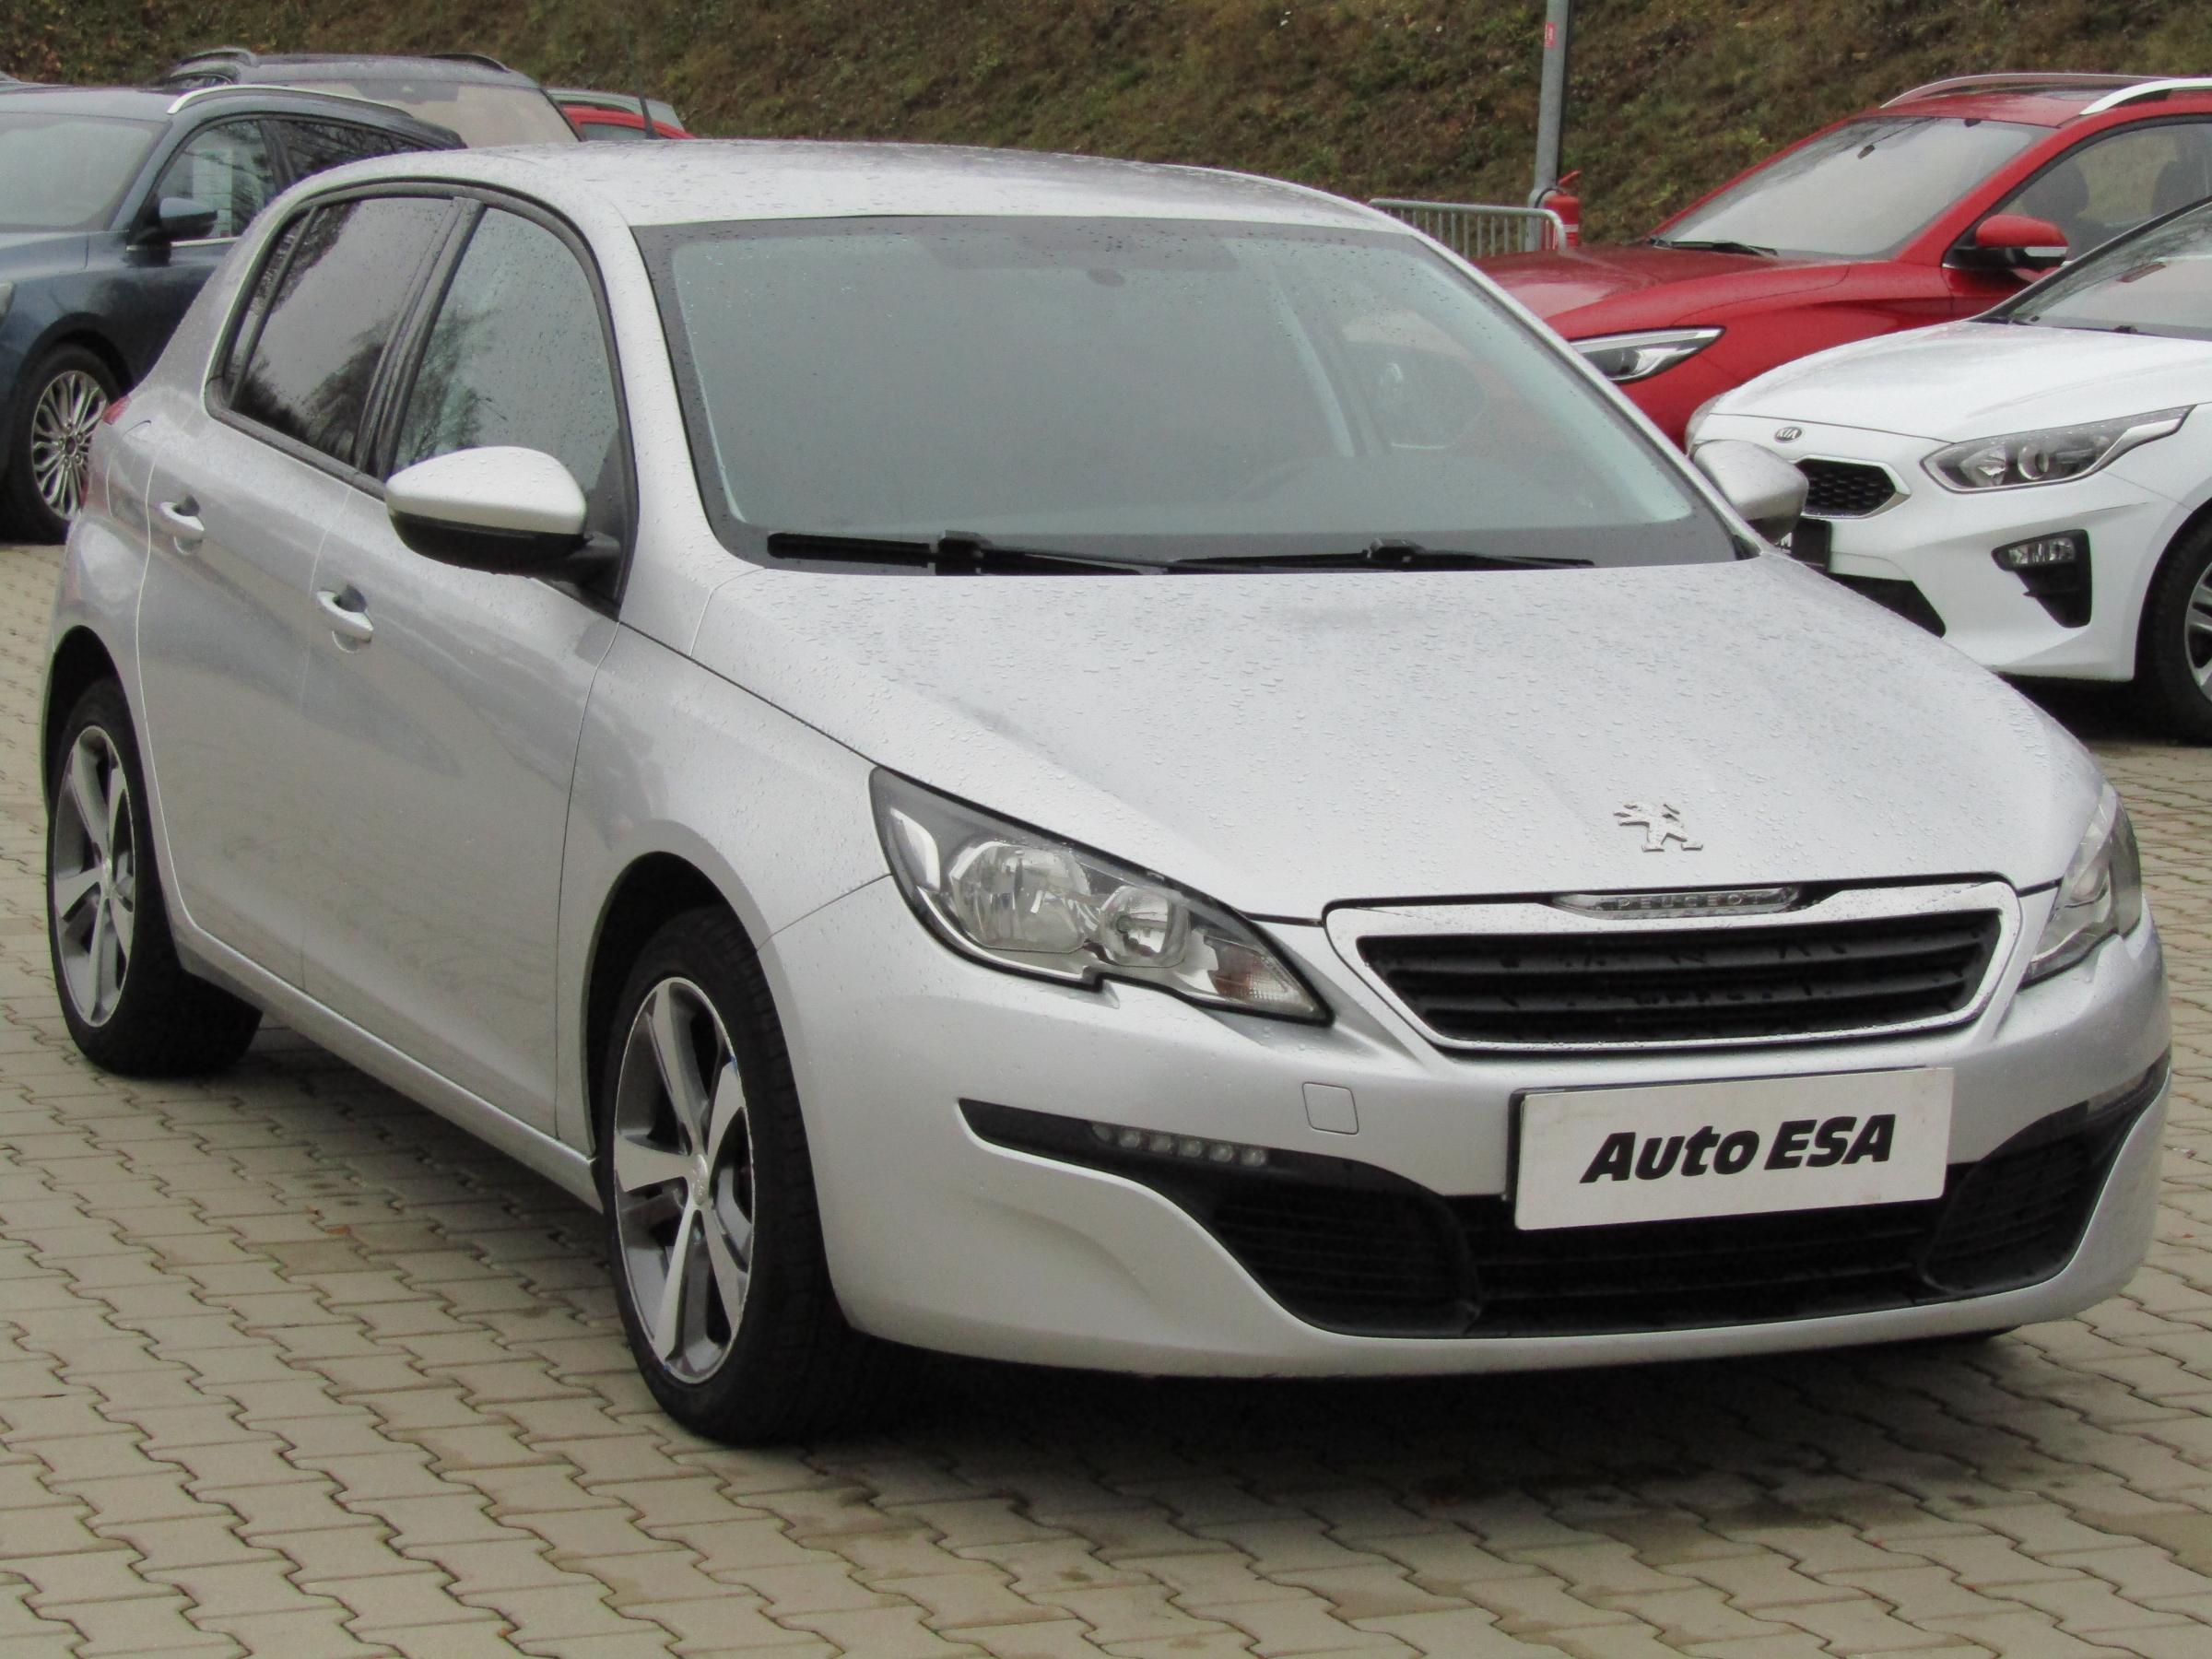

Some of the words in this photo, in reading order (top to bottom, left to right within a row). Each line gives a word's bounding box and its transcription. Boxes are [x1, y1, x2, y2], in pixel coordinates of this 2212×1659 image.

[1776, 427, 1799, 440] KIA
[1617, 891, 1762, 910] PEUGEOT
[1579, 1125, 1760, 1184] Auto
[1763, 1113, 1896, 1171] ESA
